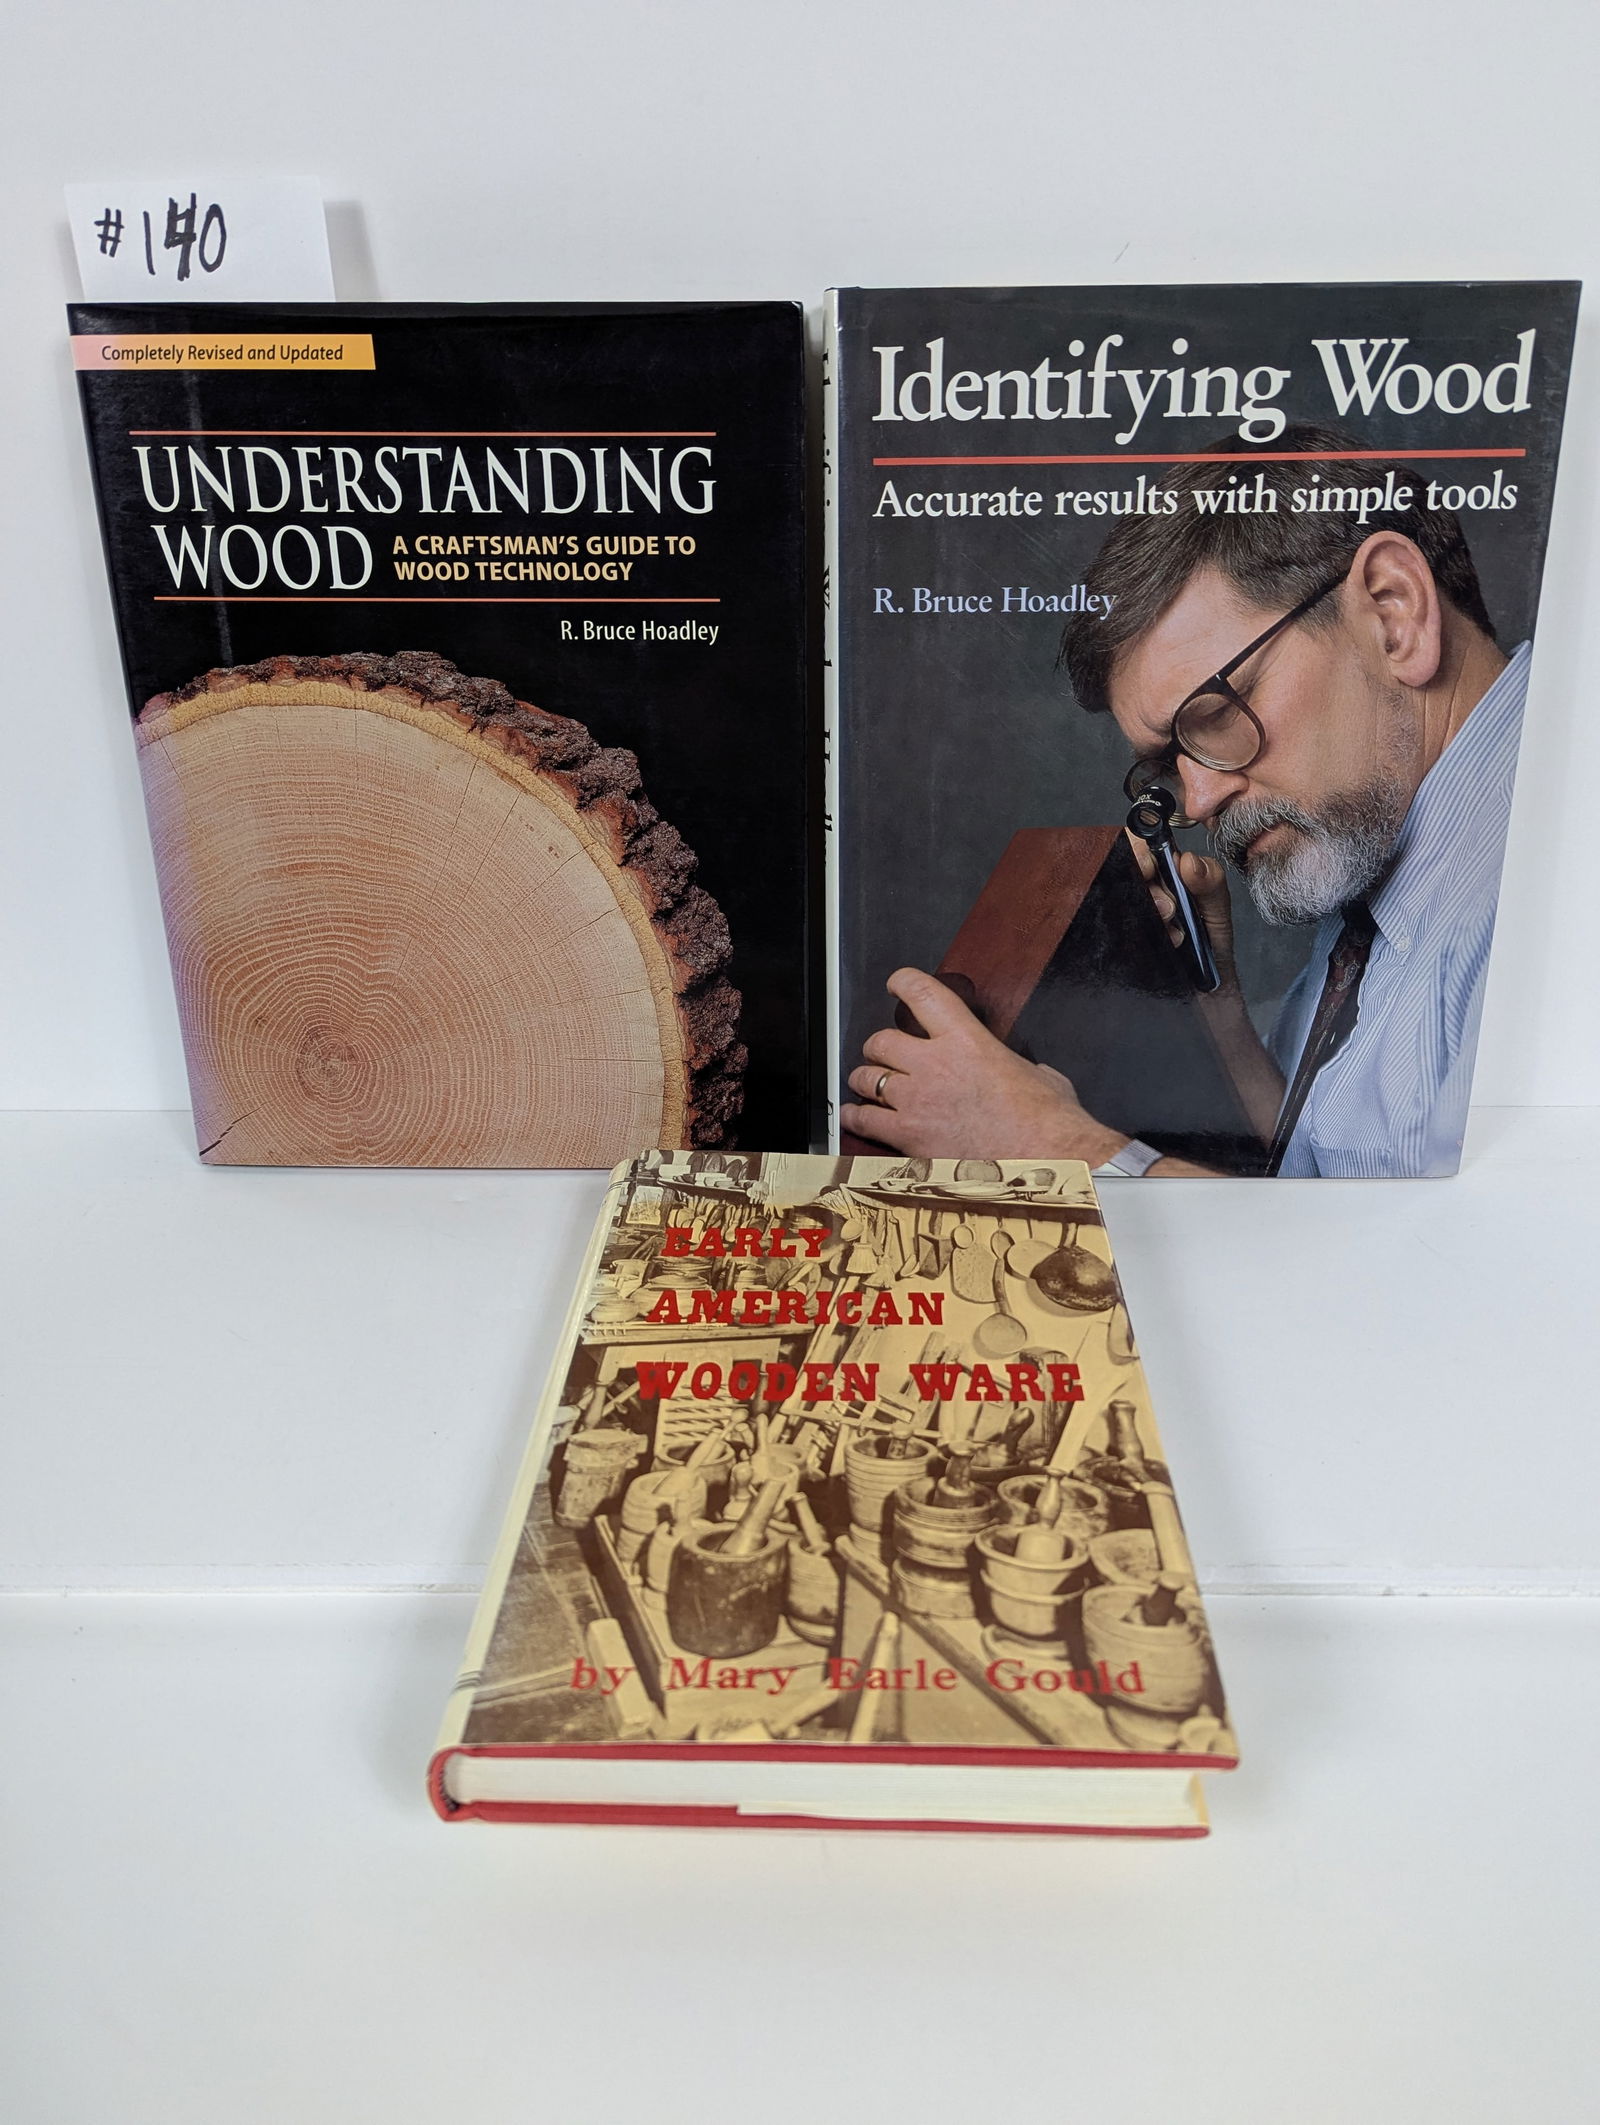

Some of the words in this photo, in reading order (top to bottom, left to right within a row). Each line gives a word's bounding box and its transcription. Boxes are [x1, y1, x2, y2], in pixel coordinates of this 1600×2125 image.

[101, 345, 184, 364] Completely
[188, 344, 244, 362] Revised
[248, 344, 275, 361] and
[279, 344, 344, 364] Updated
[872, 334, 1291, 444] Identifying
[1311, 328, 1534, 417] Wood
[132, 446, 717, 514] UNDERSTANDING
[872, 480, 1043, 517] Accurate
[1054, 476, 1179, 514] results
[1190, 474, 1278, 513] with
[1290, 473, 1413, 525] simple
[1425, 470, 1518, 511] tools
[151, 525, 374, 591] WOOD
[392, 536, 408, 555] A
[586, 535, 660, 556] GUIDE
[665, 535, 697, 556] TO
[393, 561, 470, 582] WOOD
[475, 561, 634, 582] TECHNOLOGY
[873, 588, 904, 614] R.
[912, 587, 992, 614] Bruce
[1001, 585, 1118, 620] Hoadley
[560, 622, 579, 640] R.
[583, 621, 637, 641] Bruce
[642, 620, 720, 644] Hoadley
[661, 1228, 831, 1259] EARLY
[646, 1291, 945, 1326] AMERICAN
[635, 1362, 880, 1402] WOODEN
[911, 1362, 1086, 1403] WARE
[569, 1658, 634, 1695] by
[665, 1658, 797, 1695] Mary
[826, 1656, 959, 1692] Earle
[984, 1657, 1147, 1694] Gould
